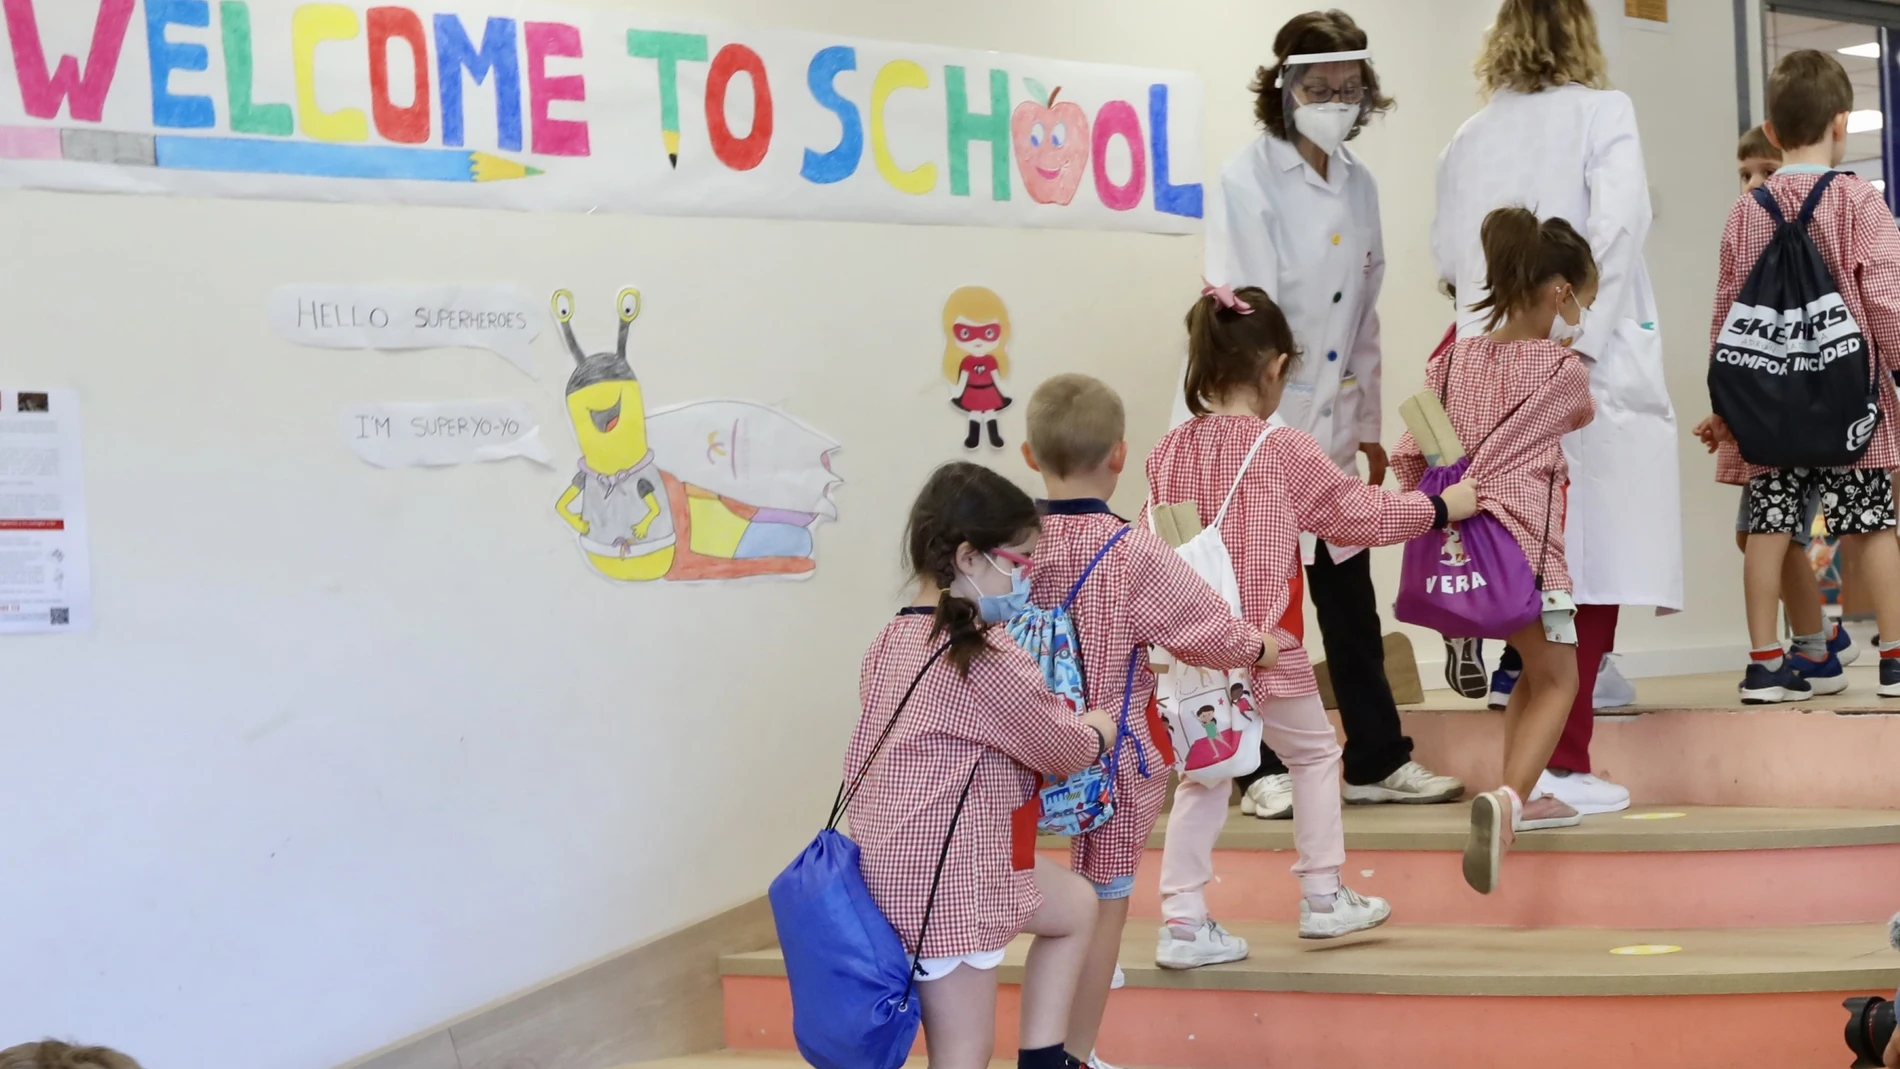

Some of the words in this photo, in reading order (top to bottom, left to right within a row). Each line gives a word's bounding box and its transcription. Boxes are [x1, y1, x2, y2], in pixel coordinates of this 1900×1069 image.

[4, 0, 590, 156] WELCOME
[627, 29, 773, 171] TO
[297, 298, 389, 330] HELLO
[414, 306, 527, 330] SUPERHEROES
[1728, 304, 1848, 345] SKEHRS
[1715, 348, 1791, 376] COMFOR
[1793, 337, 1861, 372] INCLDED
[355, 414, 391, 439] I'M
[1426, 571, 1487, 594] VERA
